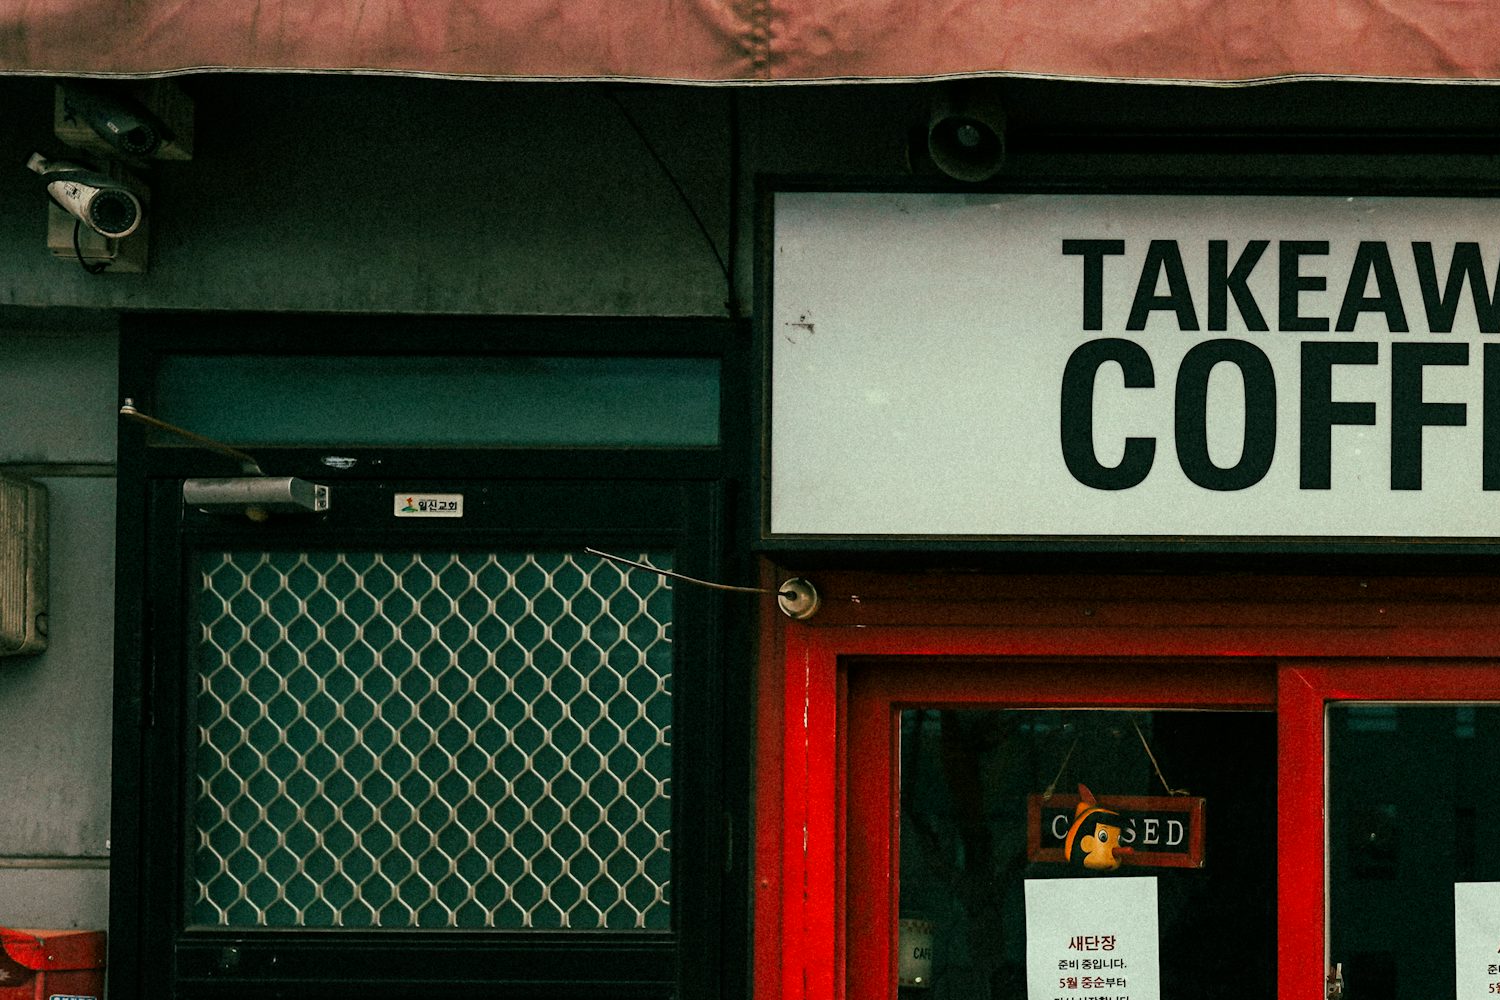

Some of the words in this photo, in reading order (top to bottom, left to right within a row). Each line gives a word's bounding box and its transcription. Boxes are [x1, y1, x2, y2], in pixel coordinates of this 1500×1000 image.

[418, 501, 458, 513] 일신교회
[1052, 814, 1184, 845] CSED
[1068, 935, 1117, 951] 새단장
[1058, 959, 1079, 970] 준비
[1081, 959, 1127, 970] 중입니다.
[1059, 977, 1078, 989] 5월
[1081, 976, 1126, 989] 중순부터
